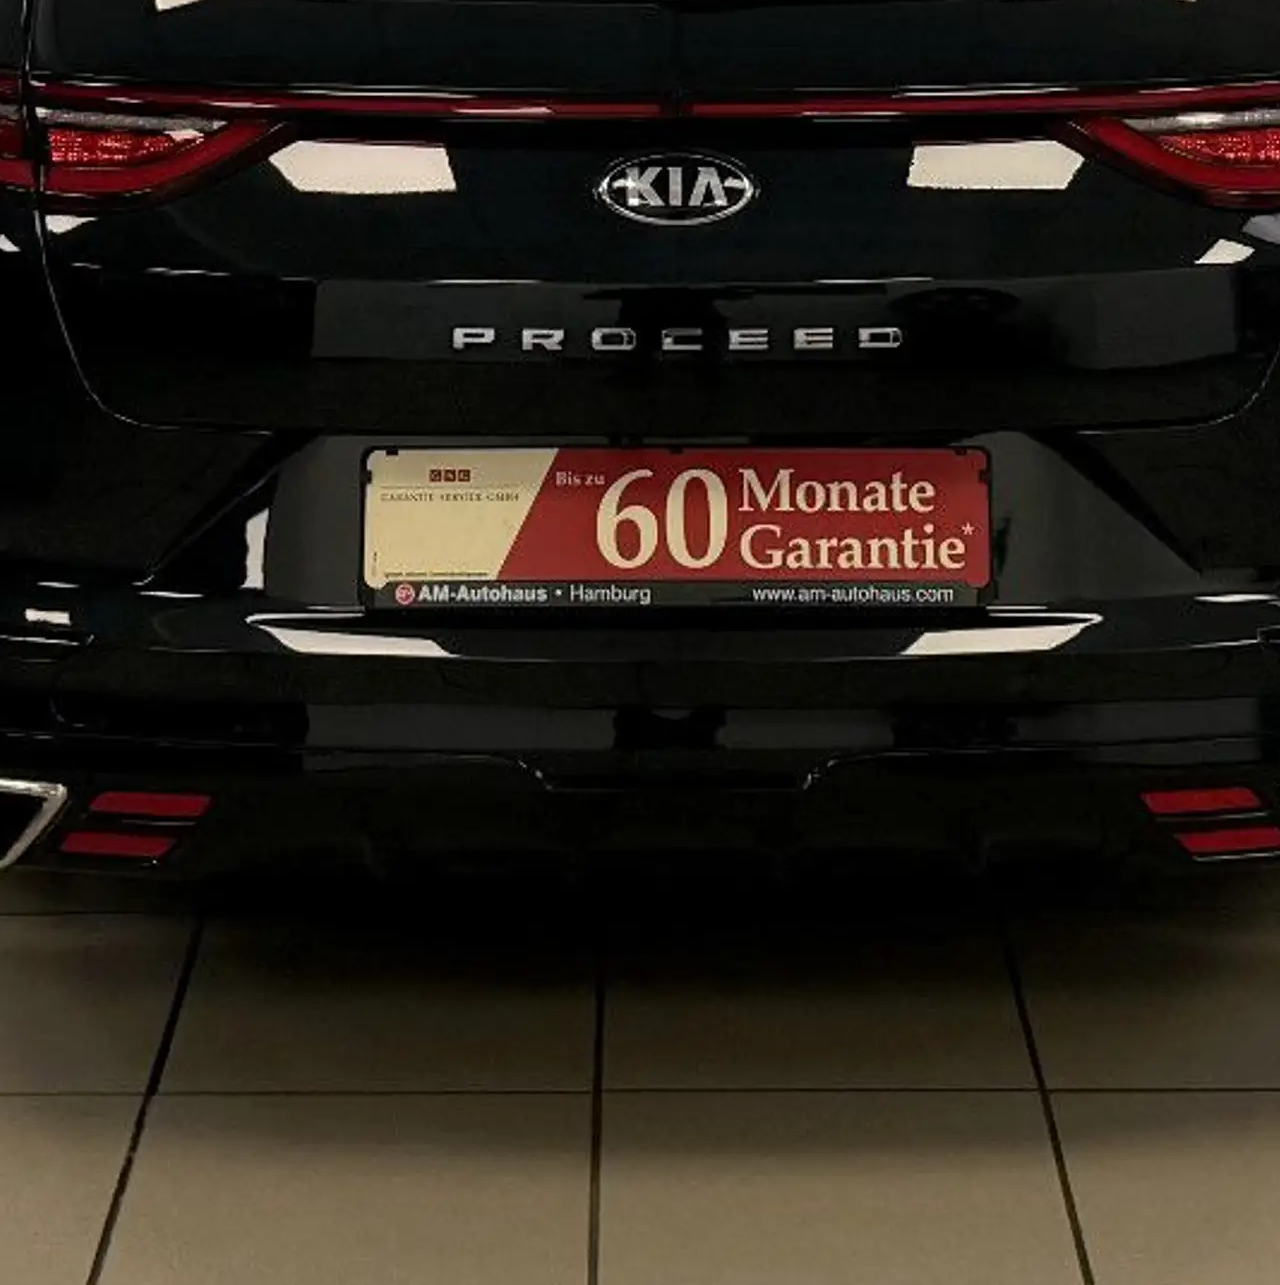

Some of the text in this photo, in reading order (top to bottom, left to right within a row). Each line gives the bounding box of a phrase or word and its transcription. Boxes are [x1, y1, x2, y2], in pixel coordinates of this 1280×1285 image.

[624, 166, 729, 207] KIA
[452, 326, 905, 352] PROCEED
[555, 471, 606, 486] Bis zu
[738, 468, 936, 513] Monate
[596, 468, 728, 570] 60
[418, 585, 652, 605] AM-Autohaus Hamburg
[752, 585, 954, 603] www.am-autohaus.com
